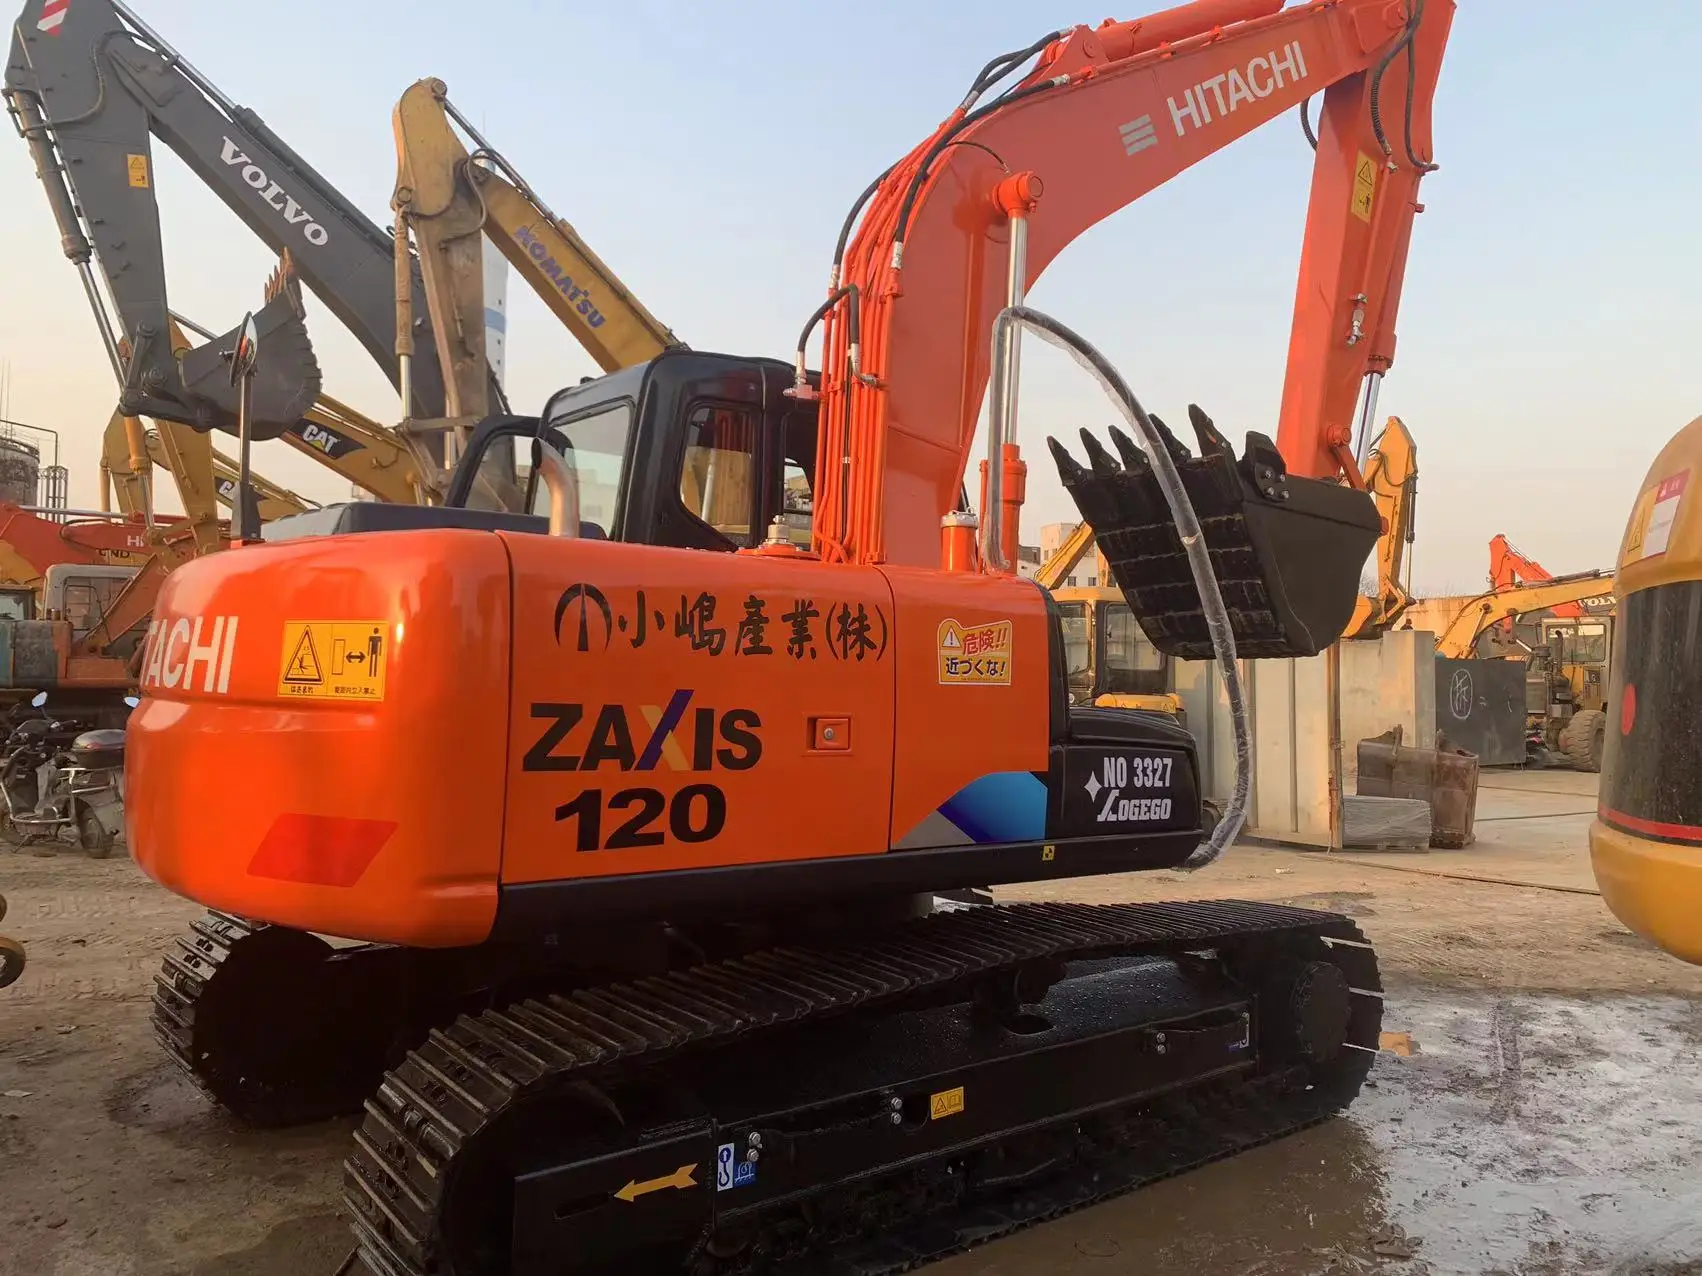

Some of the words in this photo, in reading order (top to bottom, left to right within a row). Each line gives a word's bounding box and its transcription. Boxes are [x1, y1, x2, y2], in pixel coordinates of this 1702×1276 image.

[1166, 40, 1308, 137] HITACHI
[221, 135, 329, 246] VOLVO
[514, 225, 606, 328] KOMATSU
[302, 424, 338, 453] CAT
[945, 657, 1006, 677] 近づくな!
[522, 689, 763, 772] ZAXIS
[1103, 757, 1127, 788] NO
[1133, 757, 1172, 788] 3327
[555, 783, 727, 852] 120
